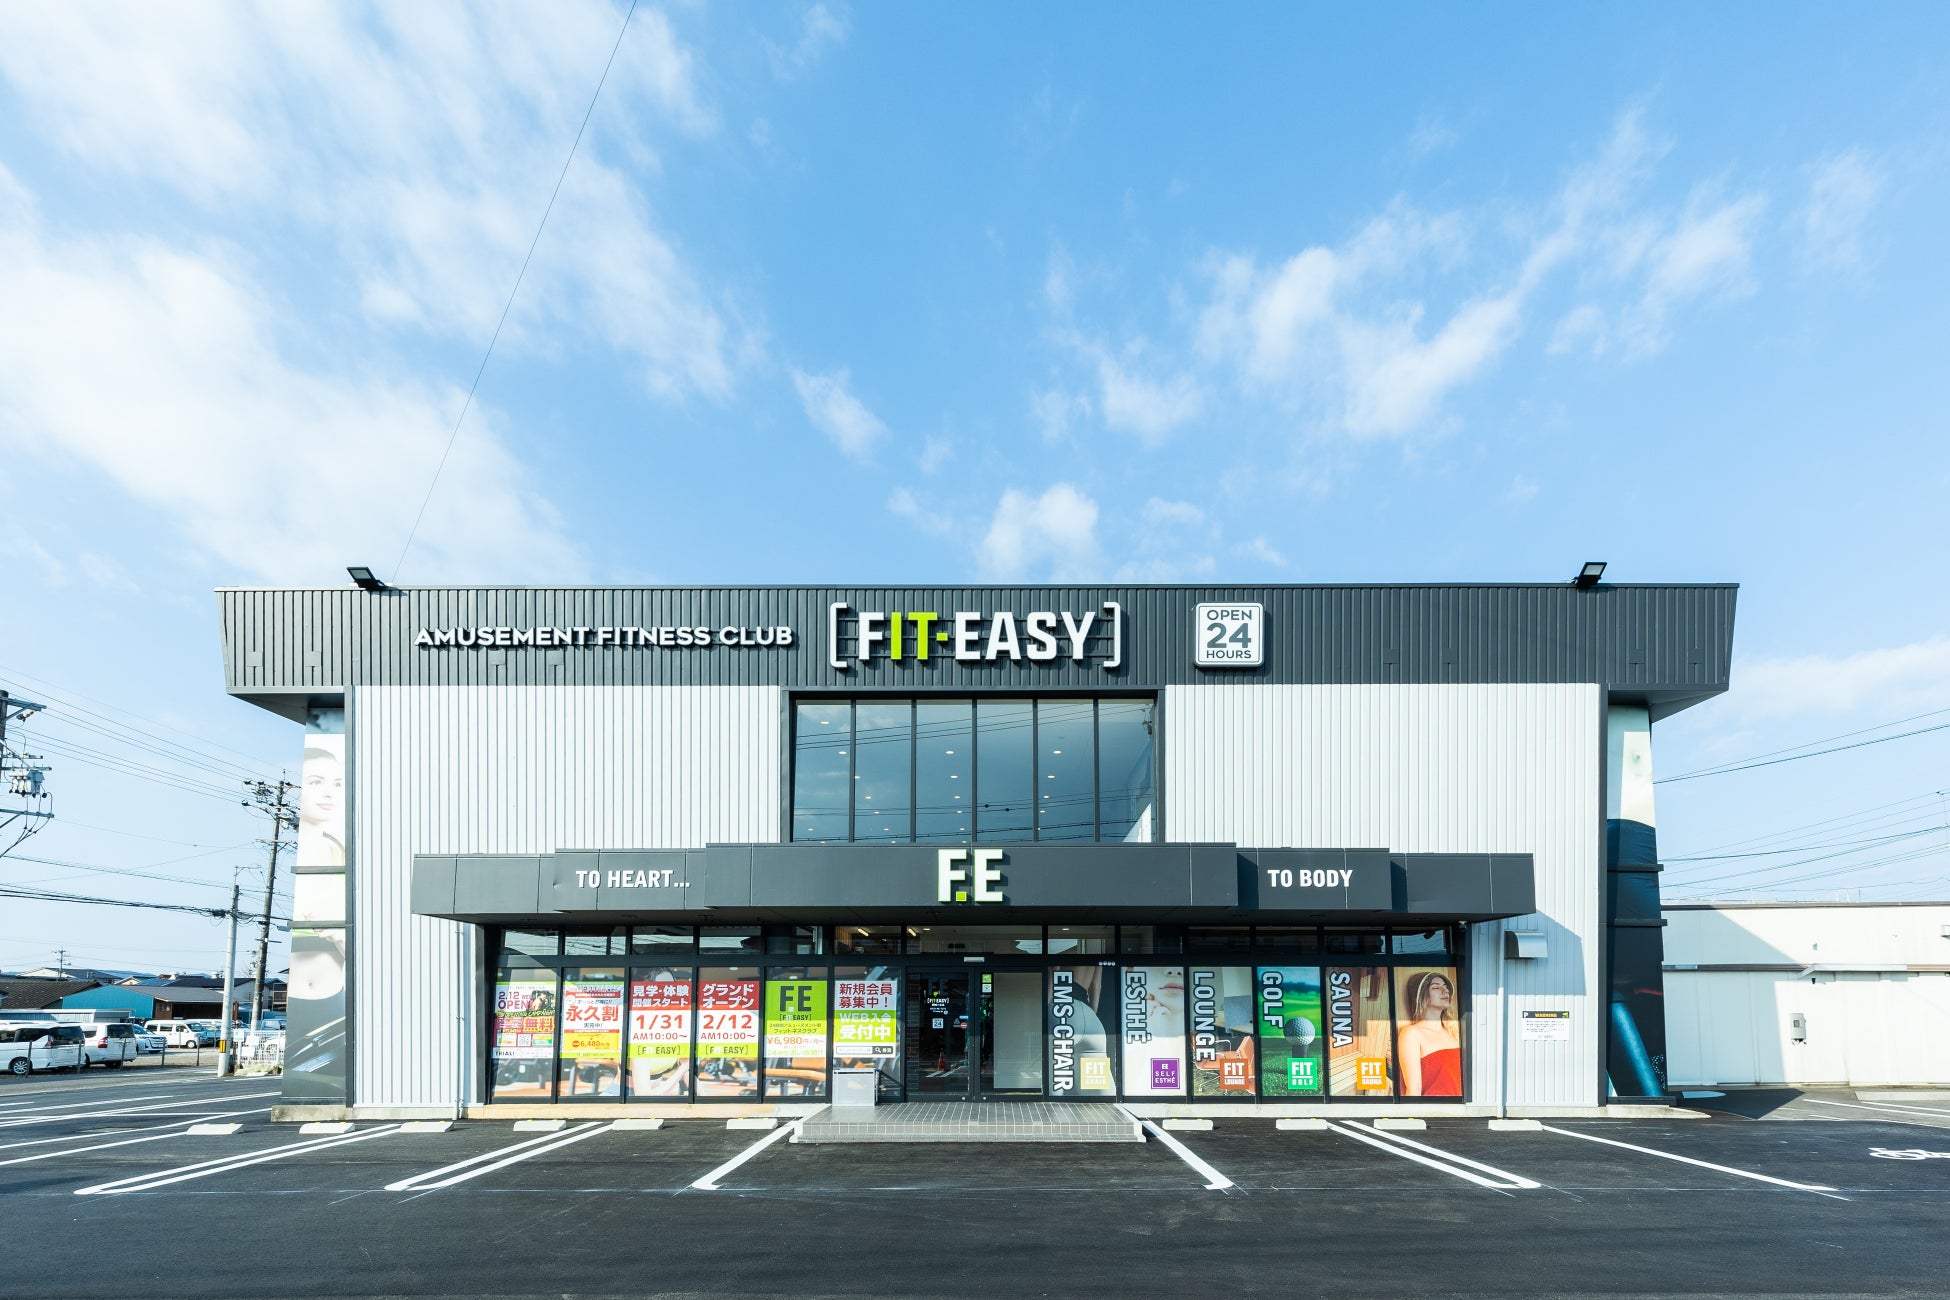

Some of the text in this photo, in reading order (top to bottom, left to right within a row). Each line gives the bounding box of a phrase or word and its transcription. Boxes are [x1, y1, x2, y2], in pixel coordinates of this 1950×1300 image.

[1206, 609, 1252, 621] OPEN
[413, 626, 793, 646] AMUSEMENT FITNESS CLUB
[1206, 622, 1252, 649] 24
[1206, 650, 1252, 659] HOURS
[575, 869, 690, 888] TO HEART...
[1267, 869, 1354, 888] TO BODY
[702, 983, 755, 996] グランド
[839, 983, 893, 996] 新規会員
[632, 997, 689, 1008] 開催スタート
[702, 996, 755, 1009] オープン
[838, 996, 889, 1009] 募集中！
[1261, 970, 1285, 1029] GOLF
[565, 1005, 619, 1022] 永久割
[1193, 970, 1216, 1062] LOUNGE
[1328, 970, 1353, 1049] SAUNA
[524, 1016, 555, 1032] 無料
[636, 1014, 683, 1030] 1/31
[703, 1014, 752, 1030] 2/12
[840, 1024, 891, 1040] 受付中
[1052, 970, 1075, 1092] EMS-CHAIR
[1085, 1061, 1106, 1075] FIT
[1224, 1062, 1245, 1076] FIT
[1291, 1061, 1313, 1075] FIT
[1360, 1061, 1382, 1075] FIT
[1224, 1078, 1246, 1086] LOUNGE
[1292, 1078, 1314, 1086] GOLF
[1361, 1078, 1382, 1086] SAUNA
